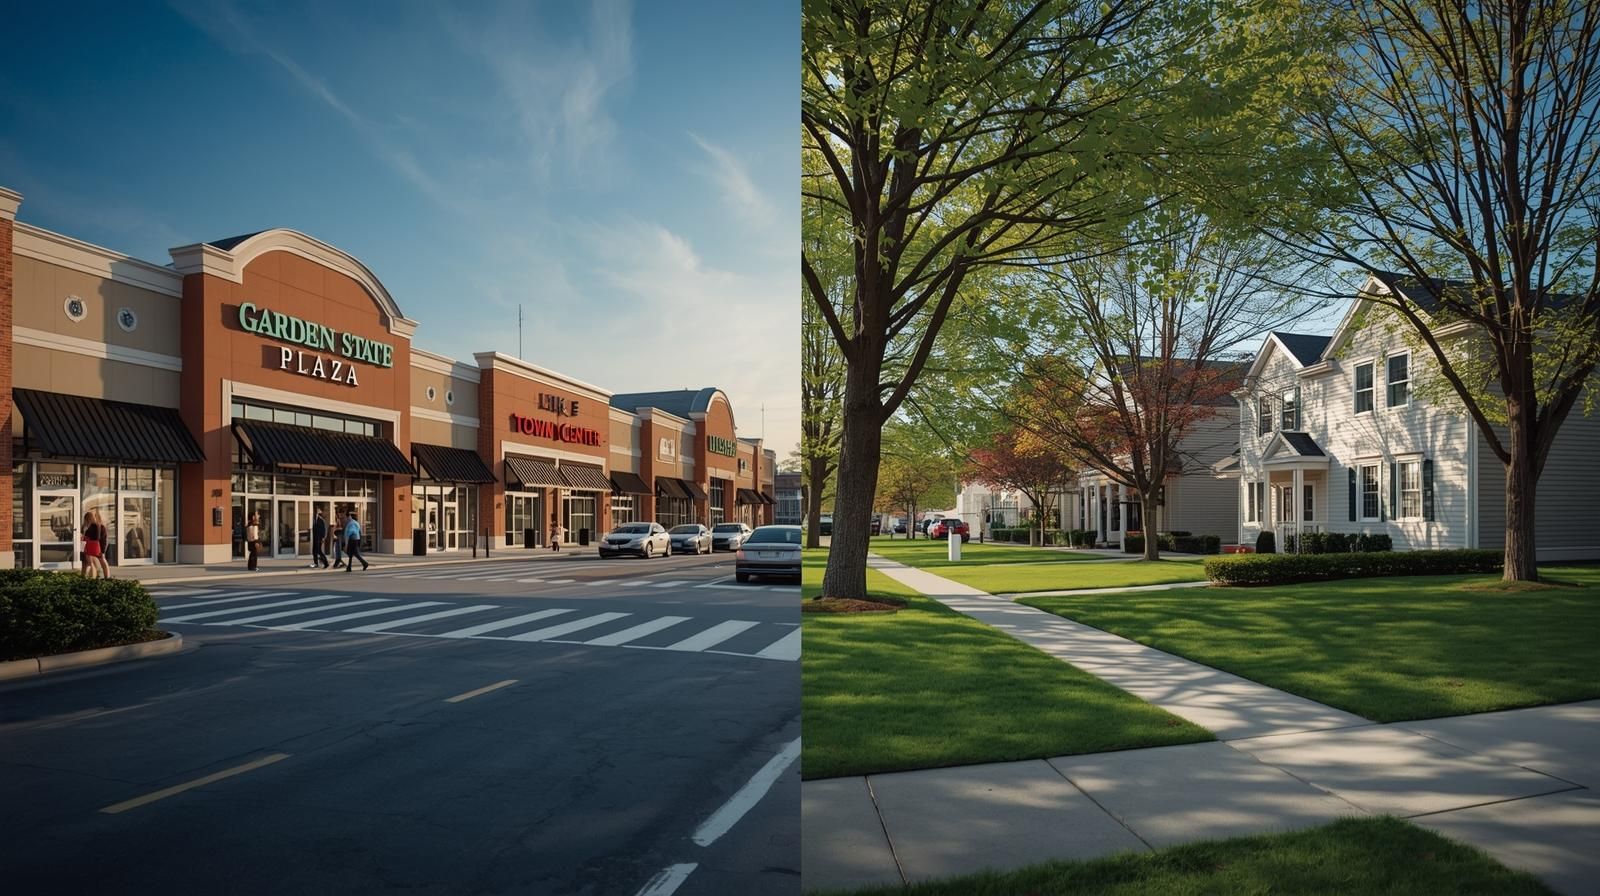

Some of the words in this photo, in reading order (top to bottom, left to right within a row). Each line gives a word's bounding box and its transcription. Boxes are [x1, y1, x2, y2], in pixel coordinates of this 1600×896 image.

[239, 302, 337, 353] GARDEN
[341, 332, 394, 368] STATE
[280, 346, 359, 386] PLAZA
[514, 415, 555, 440] TOWN
